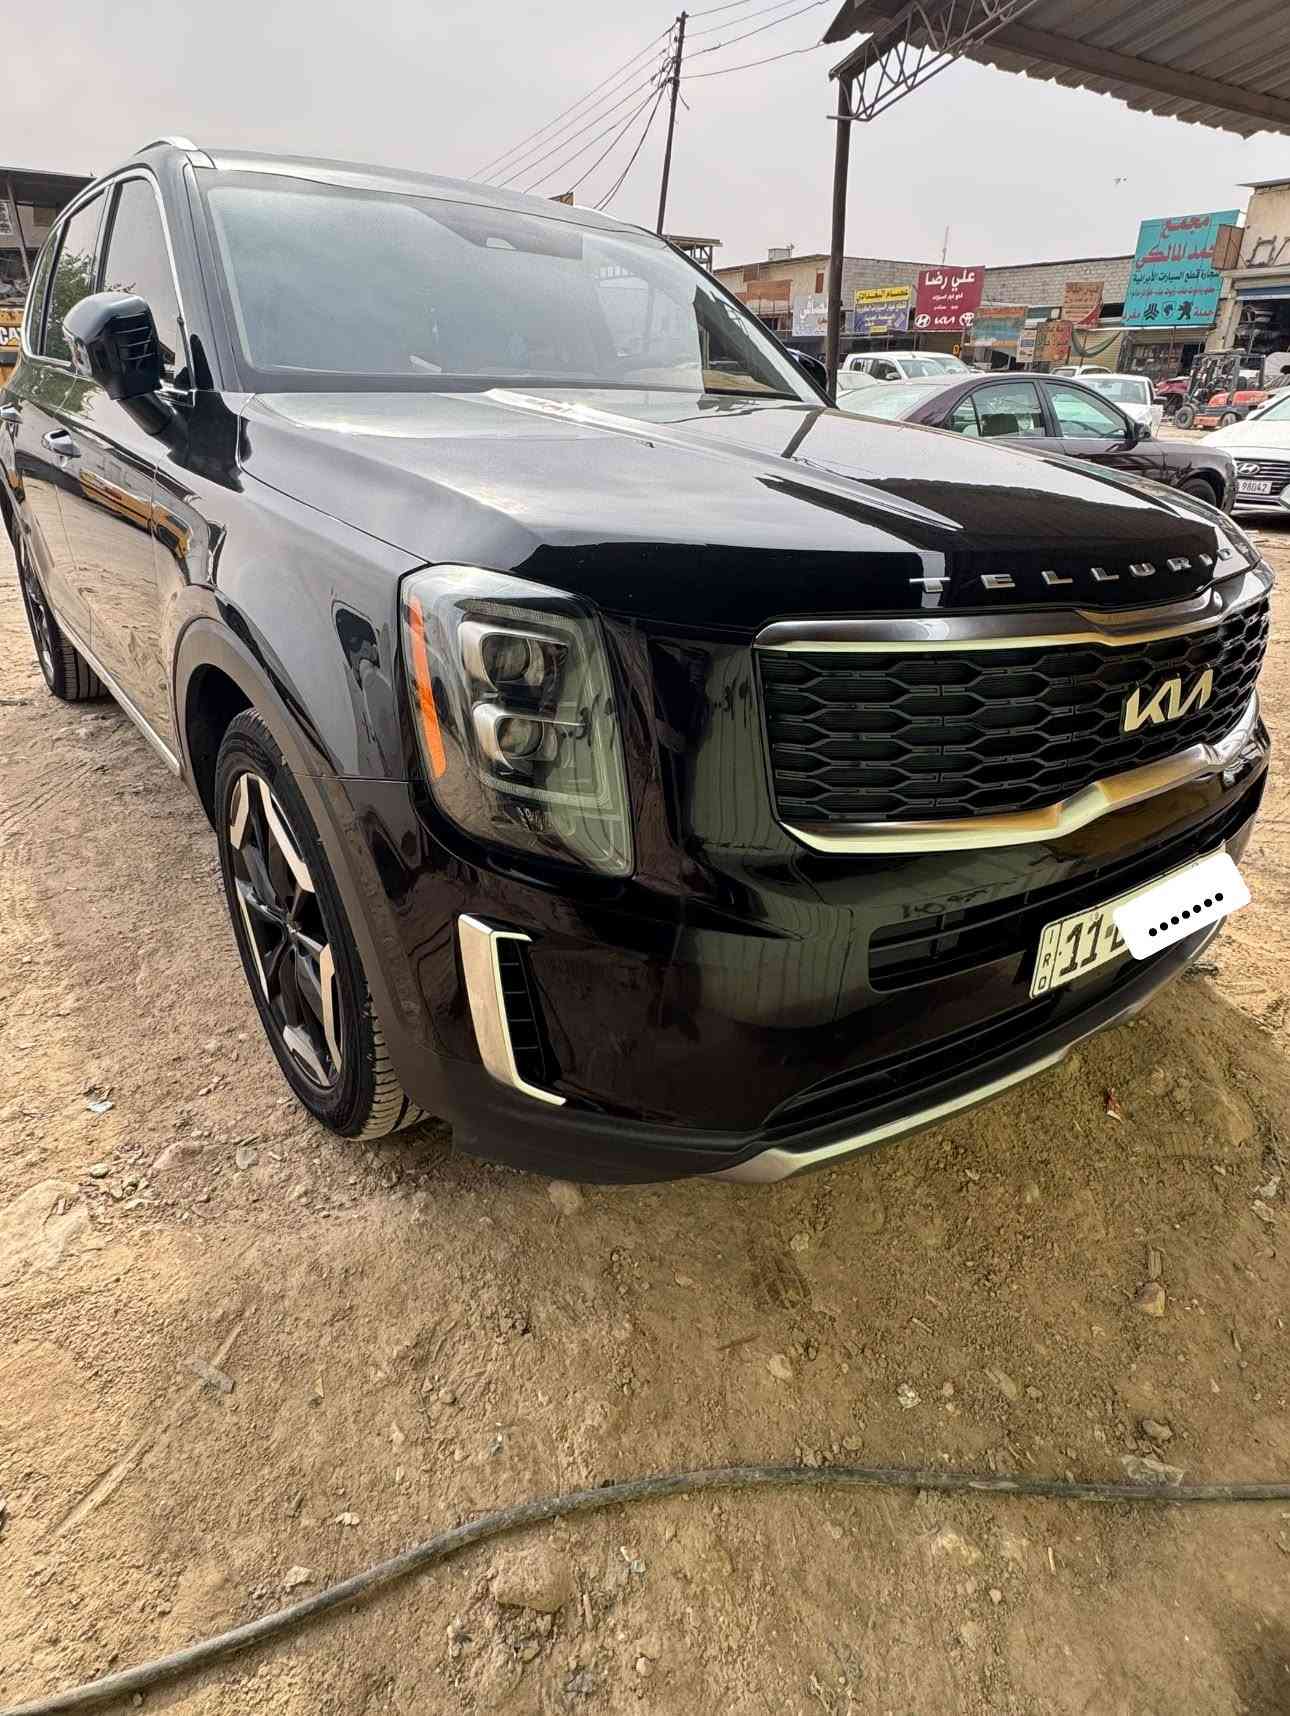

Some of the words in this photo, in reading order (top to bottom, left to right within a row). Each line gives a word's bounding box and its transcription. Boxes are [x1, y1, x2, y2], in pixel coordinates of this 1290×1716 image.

[925, 271, 948, 290] رضا
[951, 269, 975, 292] علي
[0, 326, 21, 346] CA
[1124, 669, 1213, 732] KIA
